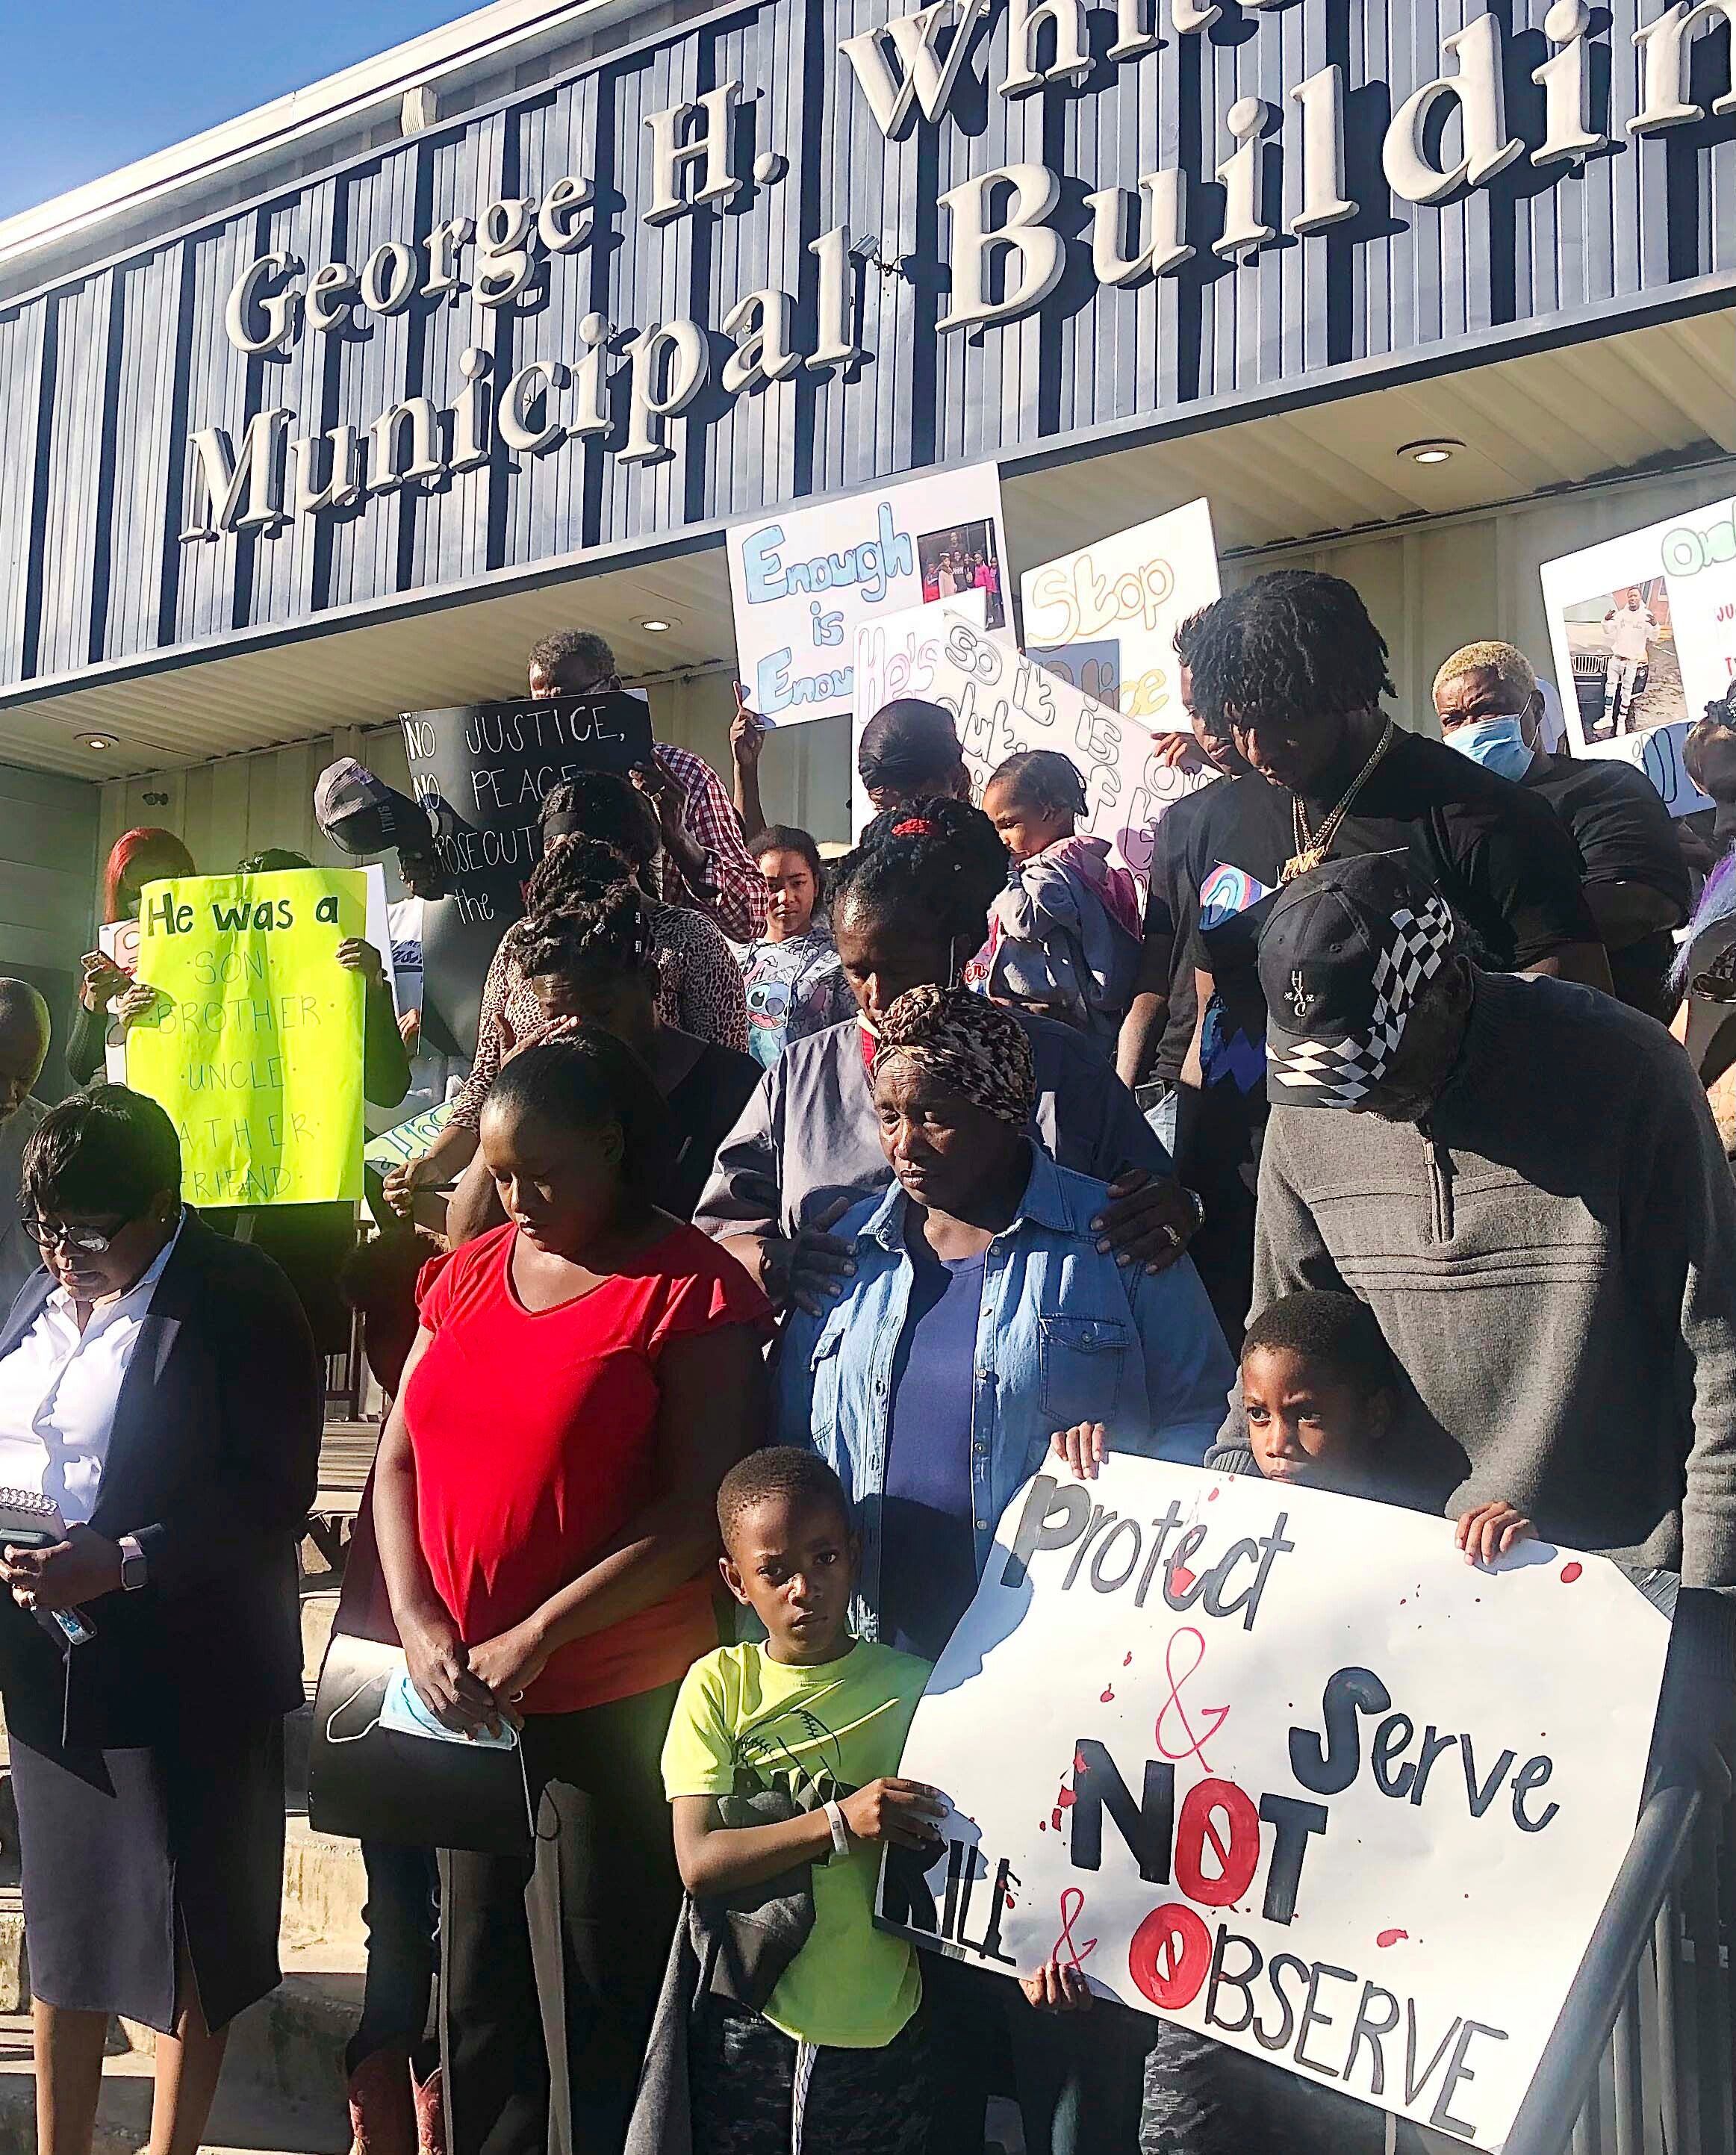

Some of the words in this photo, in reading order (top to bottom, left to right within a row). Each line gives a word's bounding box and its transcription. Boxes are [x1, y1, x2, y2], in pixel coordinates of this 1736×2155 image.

[224, 176, 596, 355] George
[642, 81, 783, 226] H.
[178, 226, 860, 544] Municipal
[936, 0, 1736, 334] Buildin
[742, 501, 913, 604] Enough
[809, 600, 844, 647] is
[1027, 554, 1175, 653] Stop
[757, 647, 853, 715] Enou
[407, 721, 436, 761] NO
[464, 705, 626, 755] JUSTICE,
[413, 772, 442, 811] NO
[147, 893, 193, 937] He
[213, 901, 294, 932] was
[315, 895, 339, 924] a
[453, 888, 494, 924] the
[193, 950, 265, 985] SON
[157, 995, 321, 1033] BROTHER
[189, 1056, 284, 1091] UNCLE
[178, 1113, 316, 1150] ATHER
[1000, 1474, 1295, 1632] Protect
[1289, 1666, 1561, 1832] Serve
[1069, 1739, 1328, 1926] NOT
